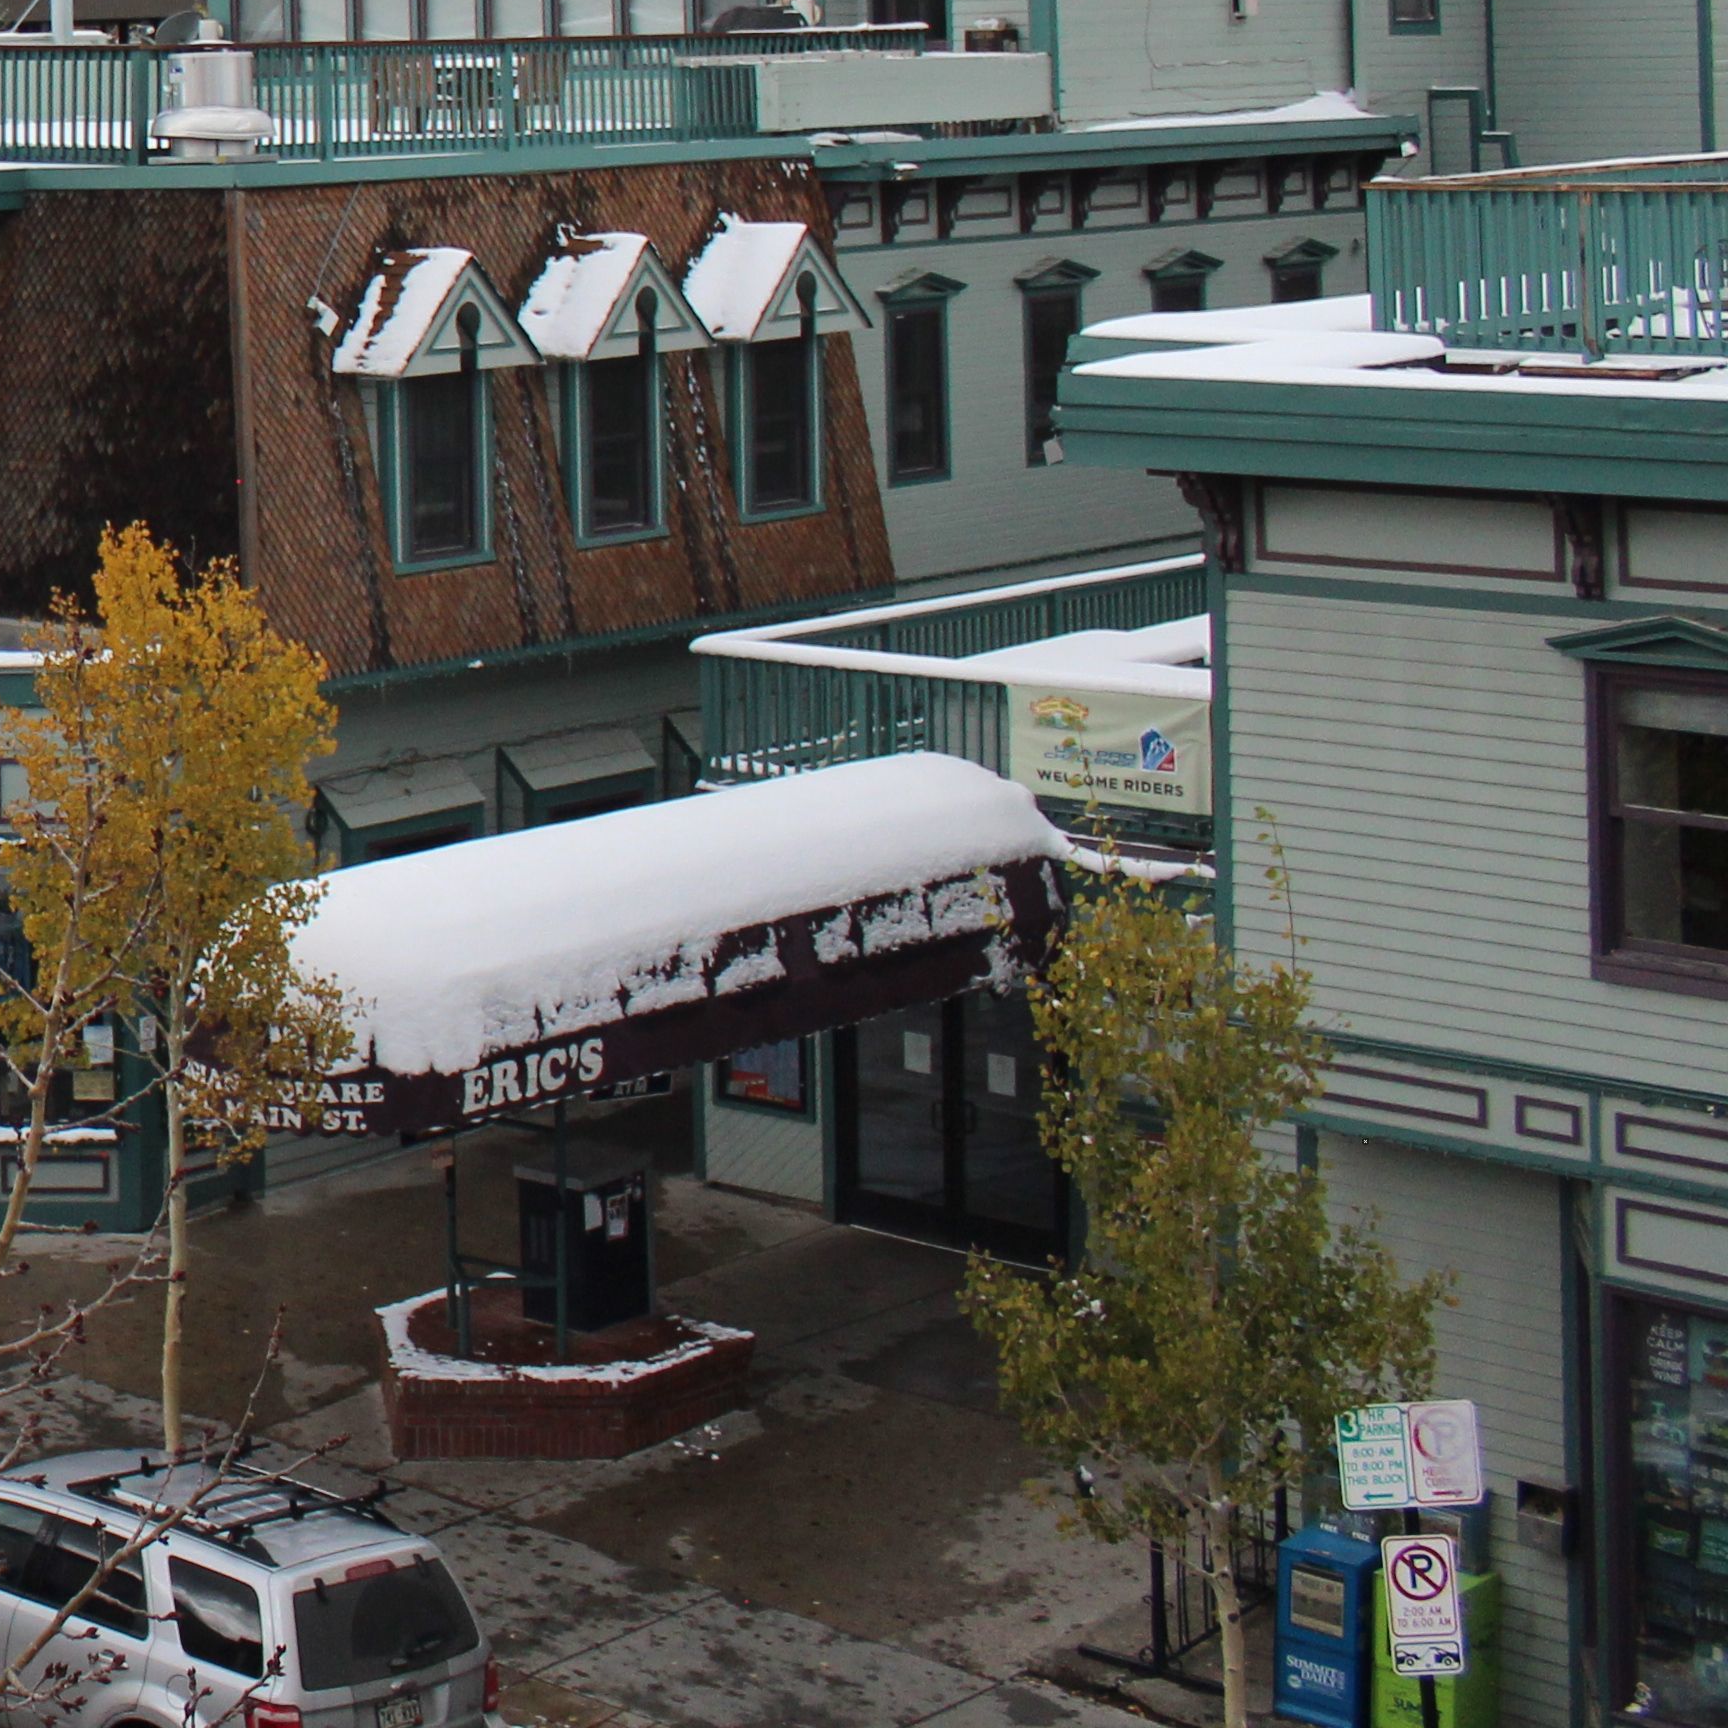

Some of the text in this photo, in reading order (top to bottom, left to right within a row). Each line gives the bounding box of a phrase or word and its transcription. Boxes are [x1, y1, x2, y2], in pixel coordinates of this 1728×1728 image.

[1124, 779, 1184, 798] RIDERS
[462, 1037, 605, 1115] ERIC'S
[613, 1075, 646, 1097] ATM
[323, 1110, 368, 1131] ST.
[1650, 1324, 1685, 1339] KEEP
[1646, 1335, 1686, 1352] CALM
[1648, 1354, 1684, 1373] DRINK
[1652, 1369, 1682, 1385] WINE
[1342, 1409, 1385, 1438] 3 HR
[1359, 1423, 1402, 1437] PARKING
[1352, 1446, 1395, 1458] 8:00 AM
[1345, 1459, 1403, 1472] TO 8:00 PM
[1346, 1474, 1405, 1486] THIS BLOCK
[1402, 1606, 1442, 1617] 2:00 AM
[1397, 1619, 1408, 1628] TO
[1438, 1616, 1451, 1626] AM
[1286, 1654, 1338, 1678] SUMMIT
[1300, 1668, 1335, 1689] DAILY
